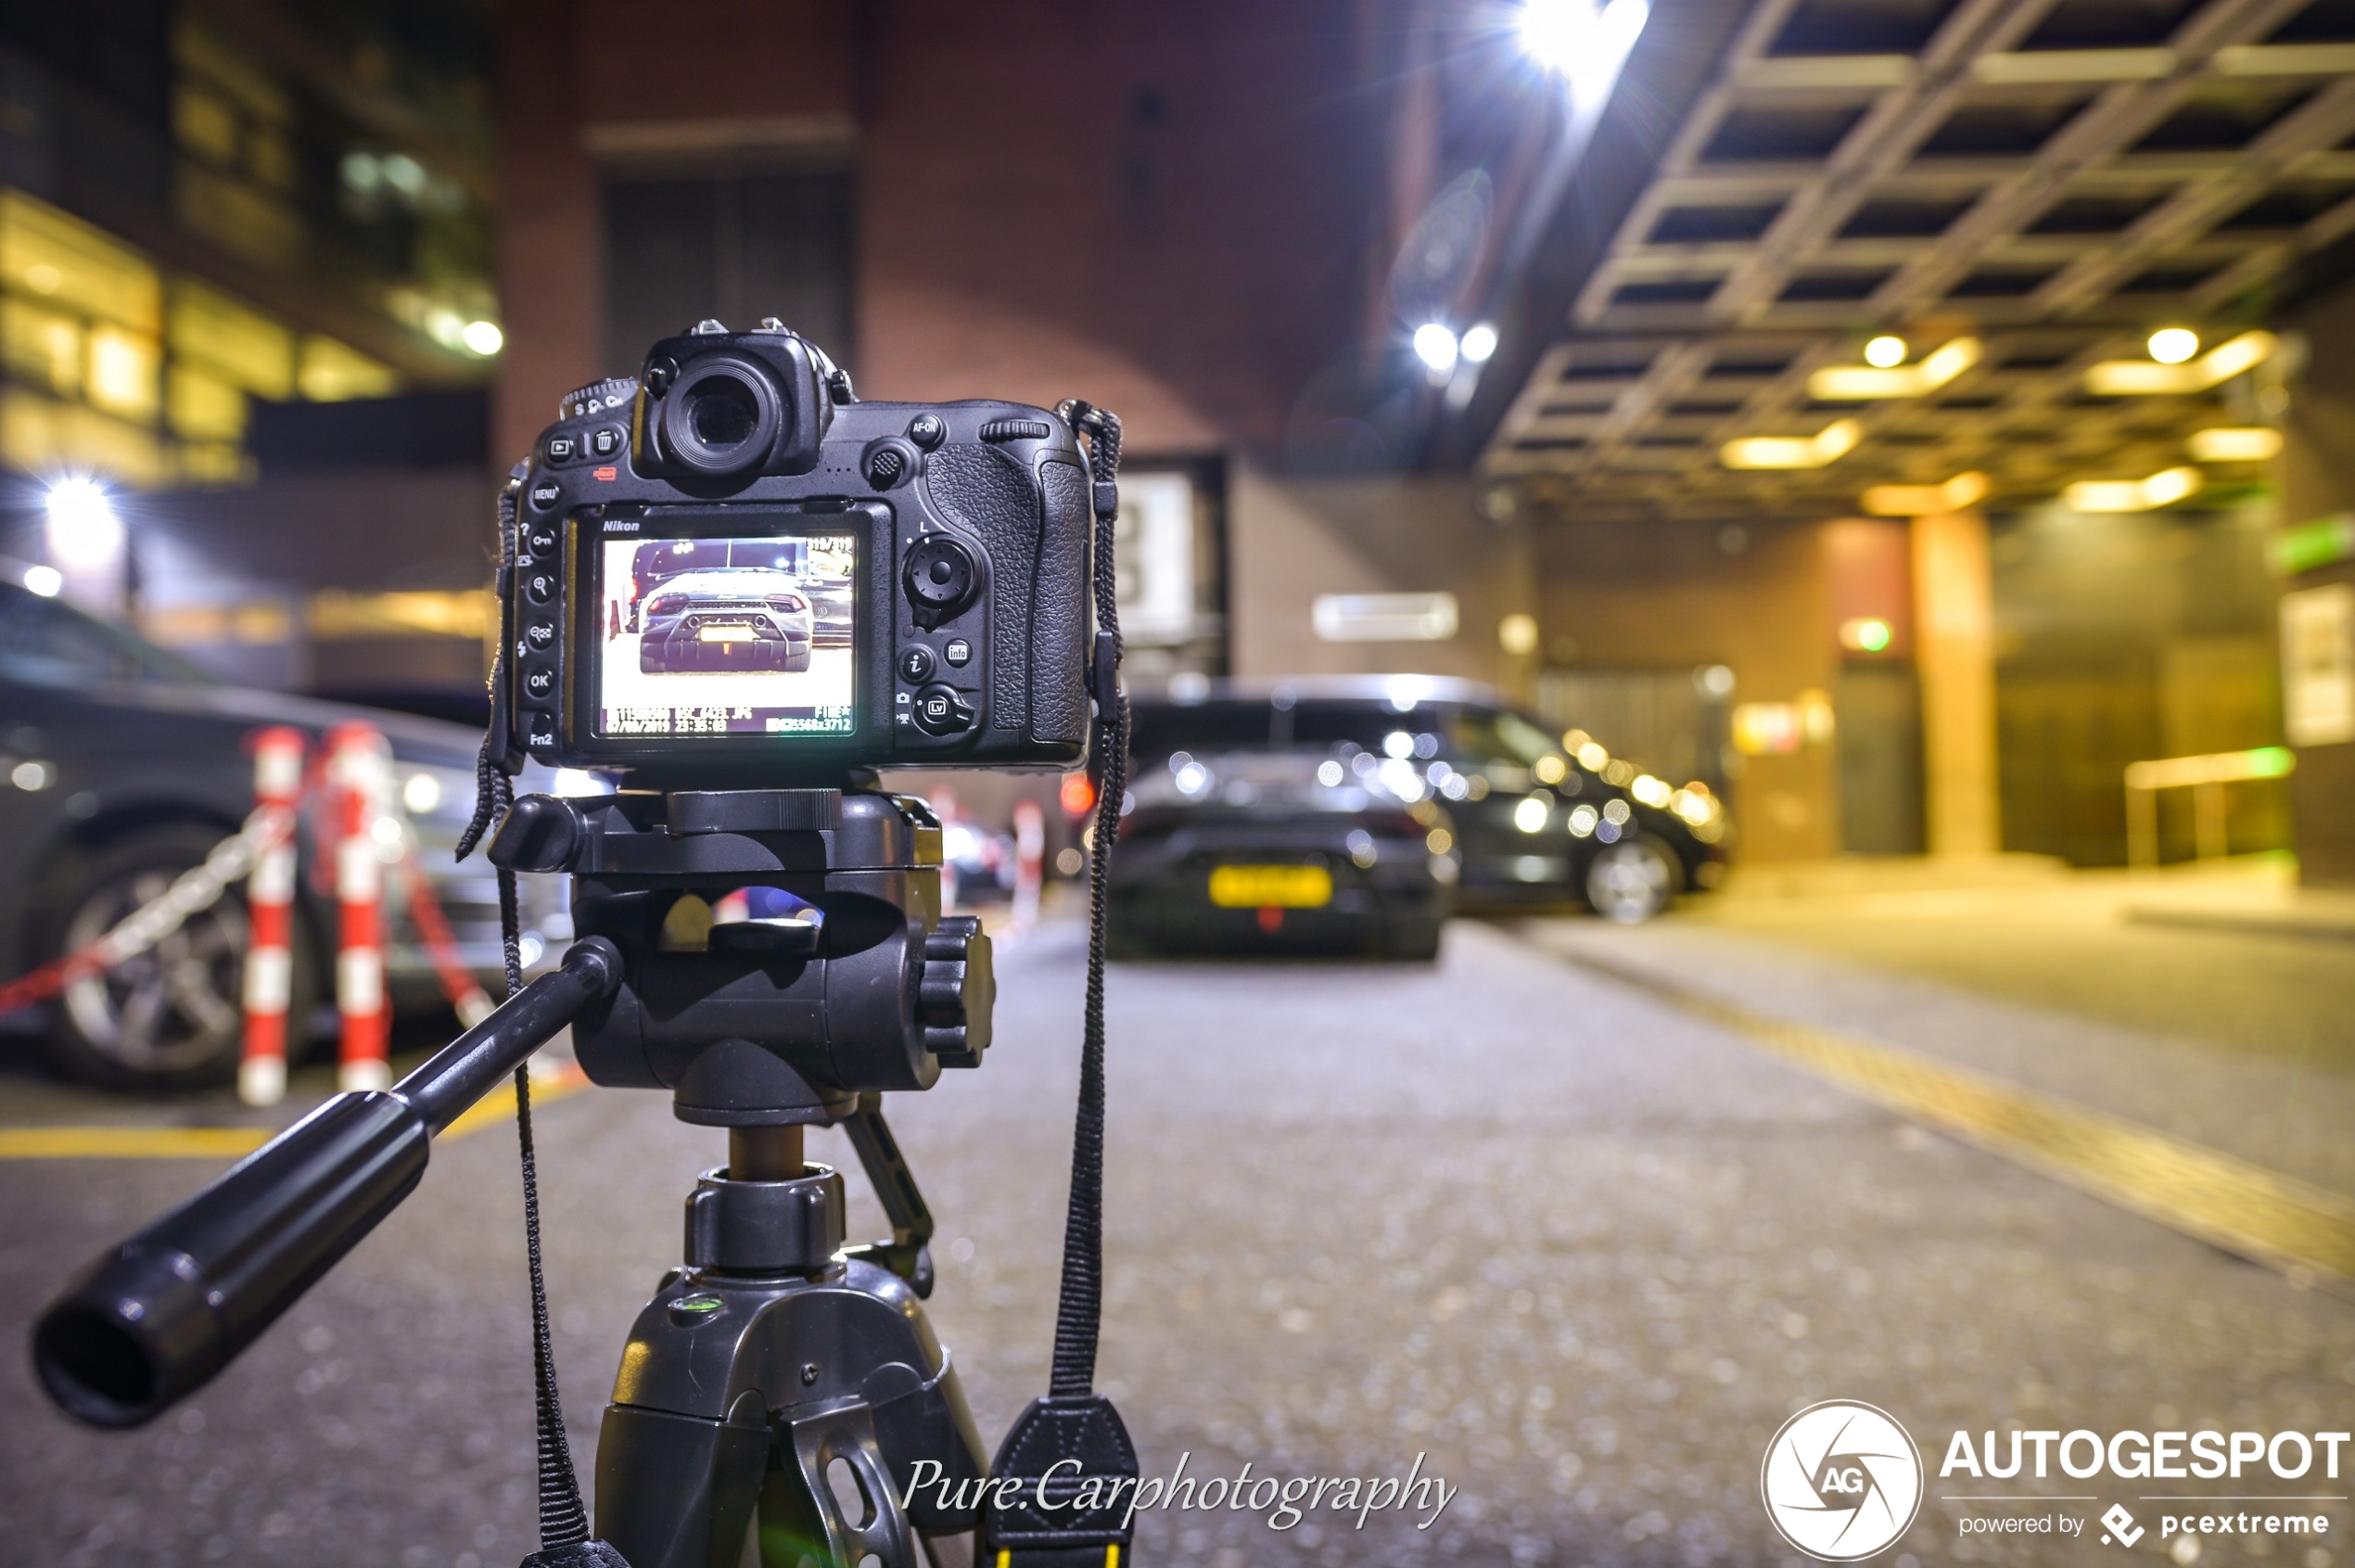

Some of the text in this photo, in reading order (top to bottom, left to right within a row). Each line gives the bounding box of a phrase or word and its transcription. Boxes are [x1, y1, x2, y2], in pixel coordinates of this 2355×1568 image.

[912, 423, 936, 433] AF-ON
[535, 489, 555, 499] MENU
[604, 521, 640, 532] Nikon
[950, 647, 966, 658] info
[910, 655, 922, 672] i
[531, 676, 549, 688] OK
[931, 703, 943, 713] Lv
[530, 734, 553, 746] Fn2
